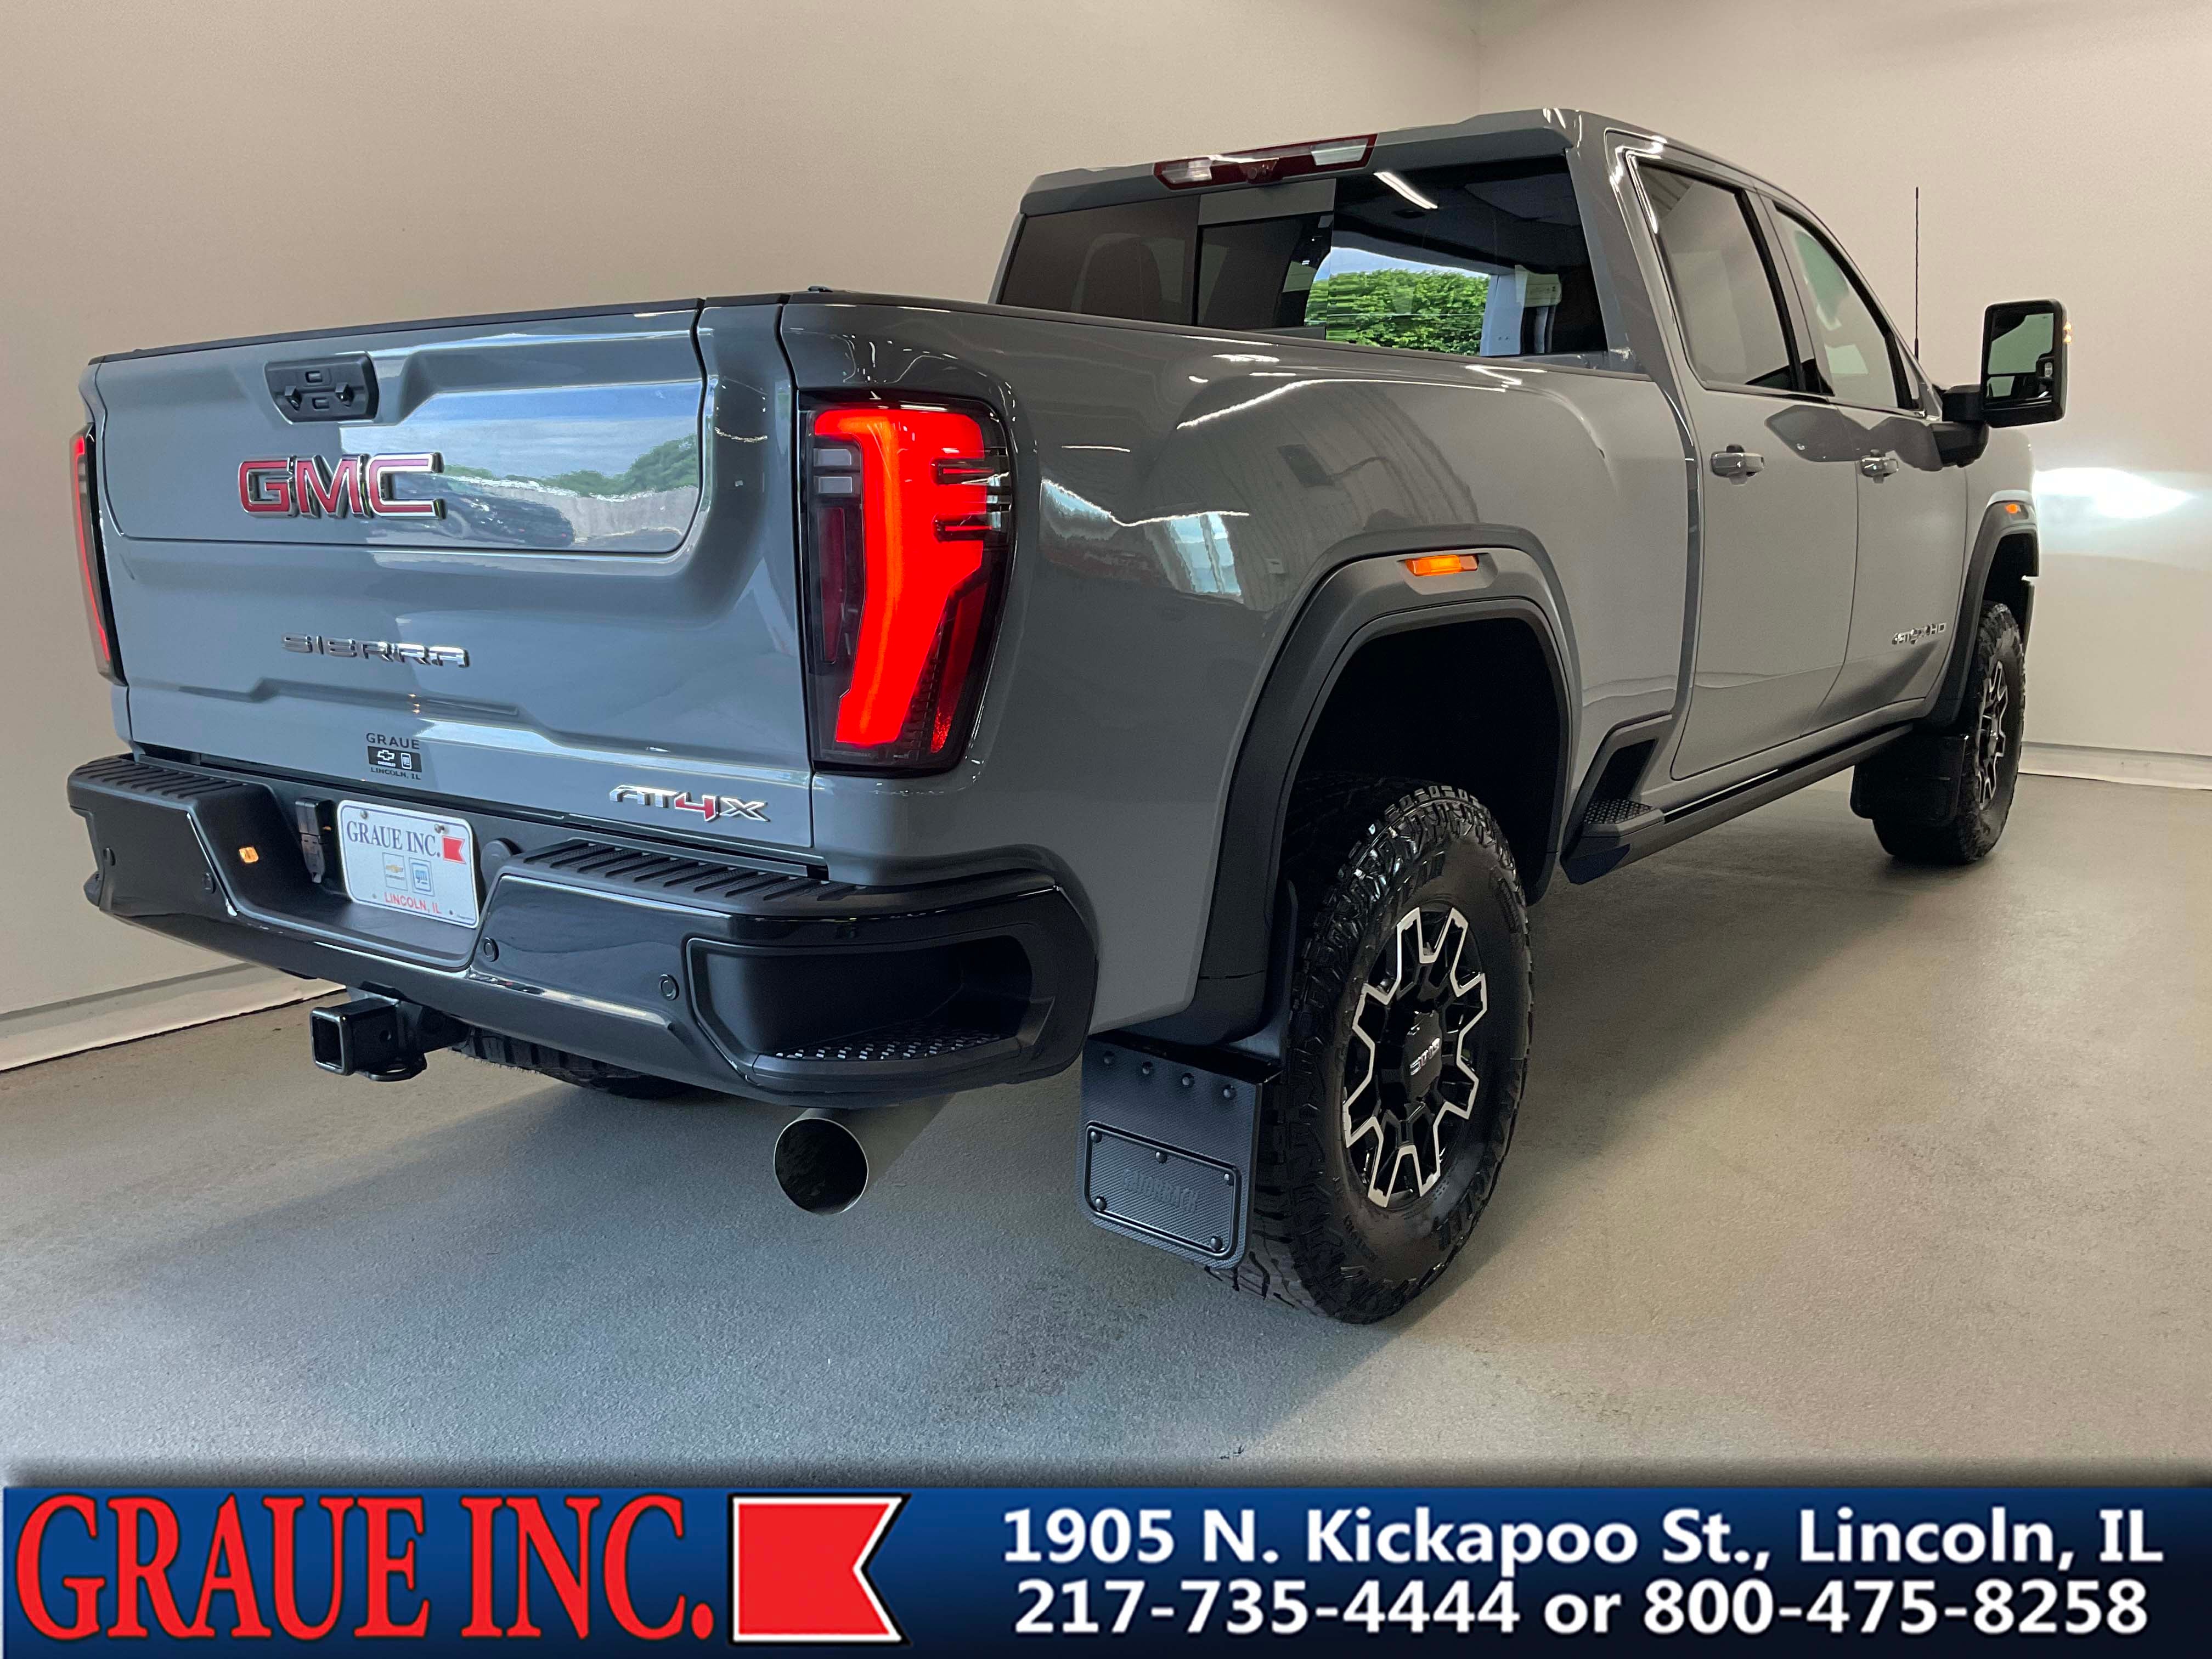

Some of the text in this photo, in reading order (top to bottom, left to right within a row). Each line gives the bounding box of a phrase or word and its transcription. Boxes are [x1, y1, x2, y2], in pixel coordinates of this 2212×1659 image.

[239, 452, 447, 520] GMC
[281, 633, 470, 668] SIERRA
[366, 732, 420, 750] GRAUE
[370, 767, 409, 779] LINCOLN,
[610, 785, 770, 822] AT4X
[347, 820, 440, 857] GRAUE INC.
[383, 891, 442, 914] LINCOLN, IL
